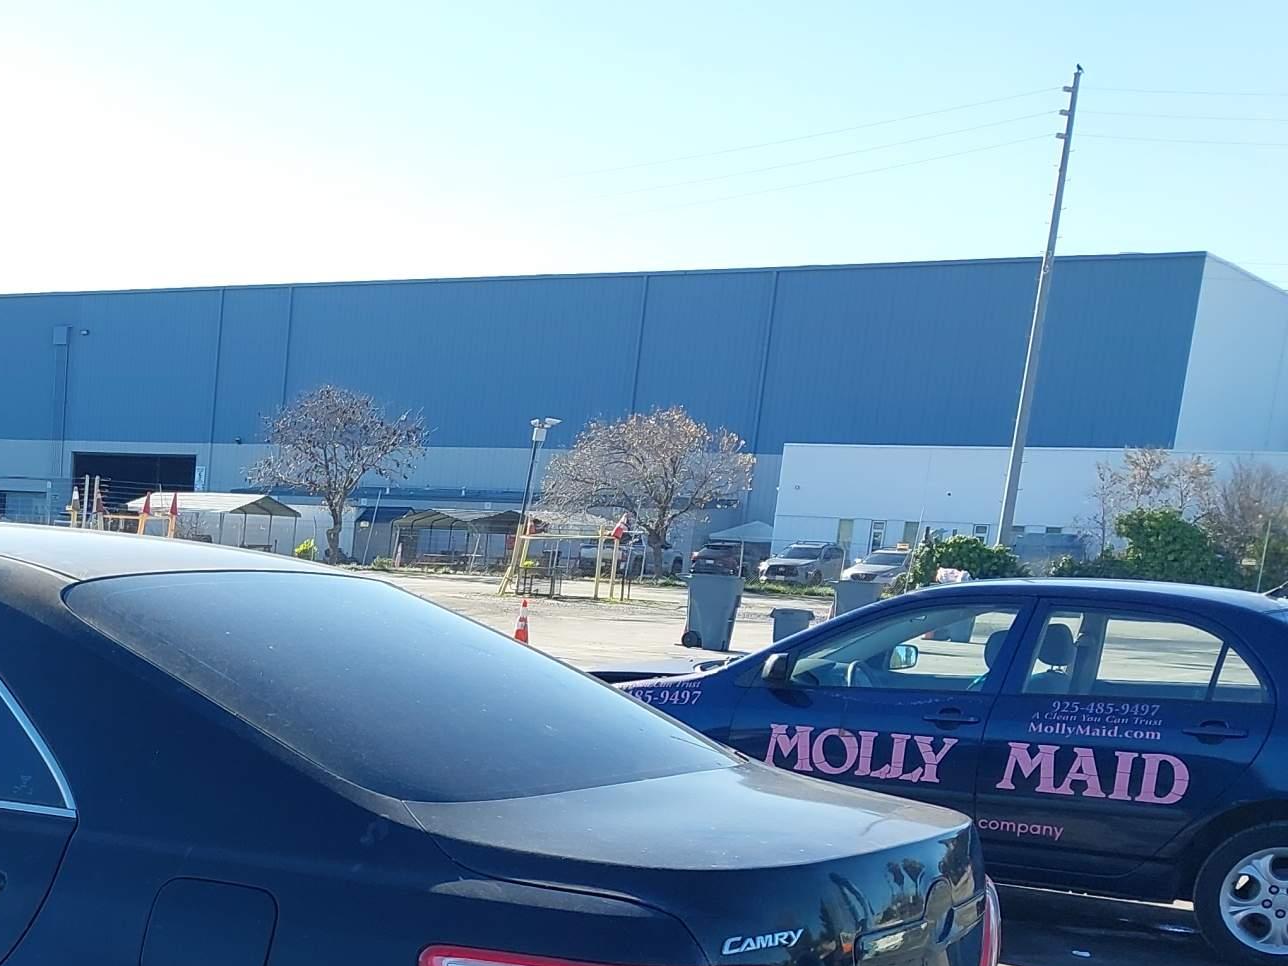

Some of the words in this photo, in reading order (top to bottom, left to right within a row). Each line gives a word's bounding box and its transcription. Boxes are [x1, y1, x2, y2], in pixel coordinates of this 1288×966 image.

[1052, 701, 1161, 716] 925-485-9497
[1031, 712, 1041, 720] A
[1044, 712, 1077, 722] Clean
[1081, 714, 1101, 723] You
[1105, 715, 1129, 724] Can
[1133, 716, 1163, 726] Trust
[1028, 722, 1161, 740] MollyMaid.com
[764, 723, 958, 784] MOLLY
[996, 742, 1190, 805] MAID
[978, 819, 1064, 841] company
